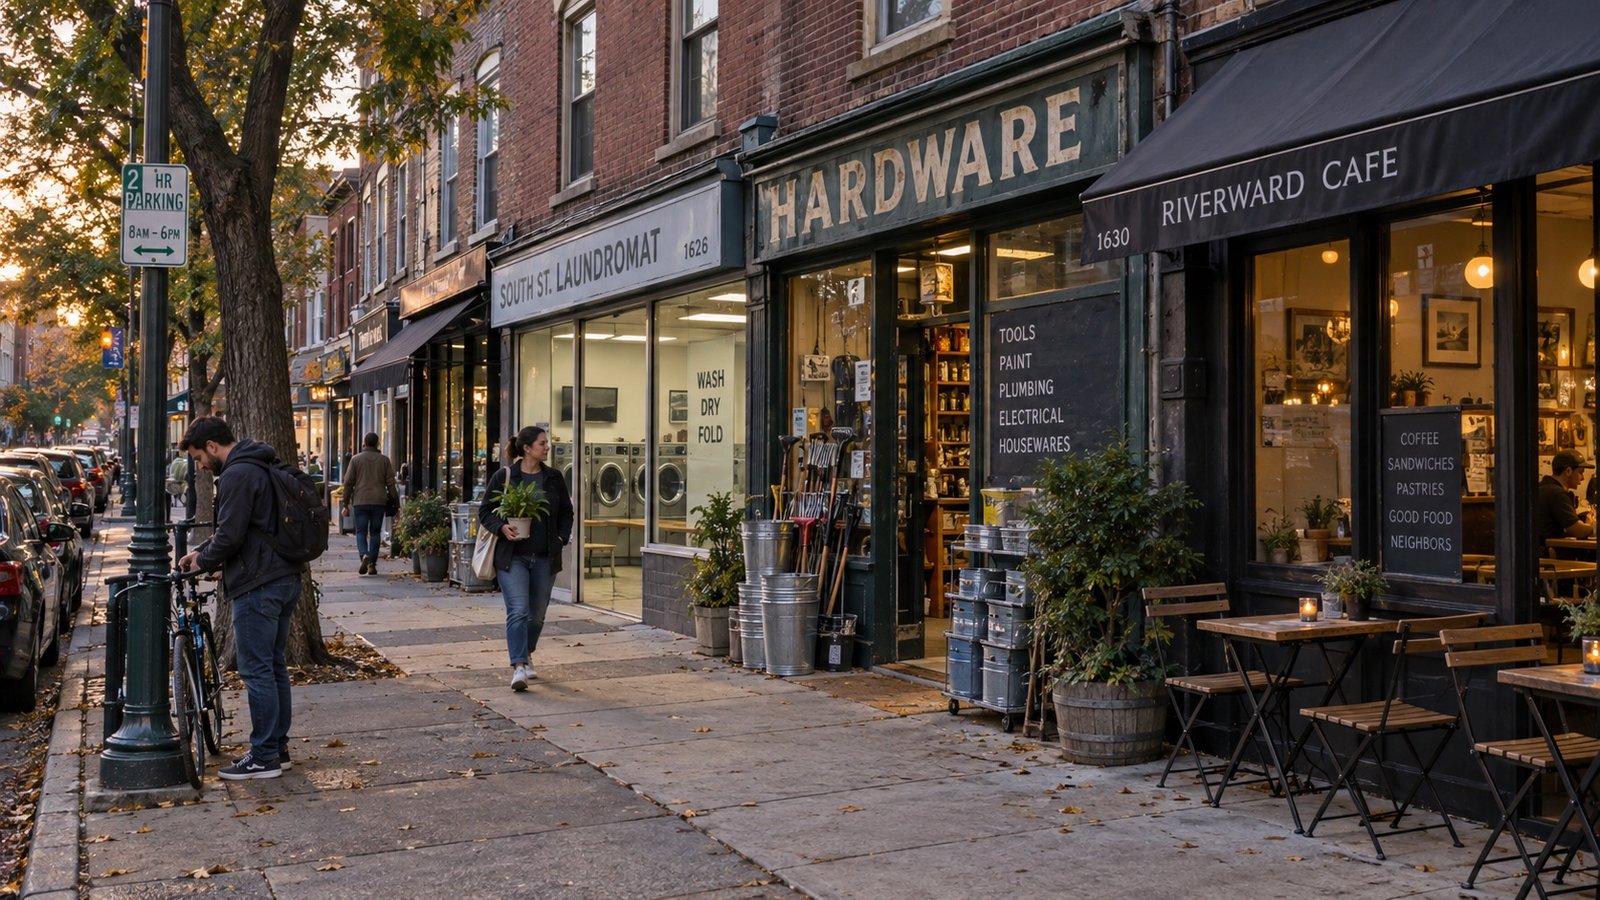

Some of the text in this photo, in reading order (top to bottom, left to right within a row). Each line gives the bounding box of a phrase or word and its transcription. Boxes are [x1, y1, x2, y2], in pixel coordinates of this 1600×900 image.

[769, 87, 1081, 245] HARDWARE
[127, 169, 172, 190] 2 HR
[1162, 146, 1398, 226] RIVERWARD CAFE
[125, 192, 183, 210] PARKING
[684, 236, 708, 260] 1626
[1097, 227, 1130, 251] 1630
[500, 227, 661, 309] SOUTH ST. LAUNDROMAT
[1000, 324, 1036, 344] TOOLS
[1000, 353, 1032, 371] PAINT
[697, 369, 725, 389] WASH
[1000, 379, 1054, 398] PLUMBING
[701, 398, 721, 416] DRY
[1000, 407, 1064, 426] ELECTRICAL
[698, 425, 723, 443] FOLD
[1400, 432, 1439, 446] COFFEE
[1000, 436, 1071, 453] HOUSEWARES
[1388, 457, 1454, 471] SANDWICHES
[1396, 482, 1444, 496] PASTRIES
[1389, 509, 1453, 525] GOOD FOOD
[1391, 535, 1452, 551] NEIGHBORS
